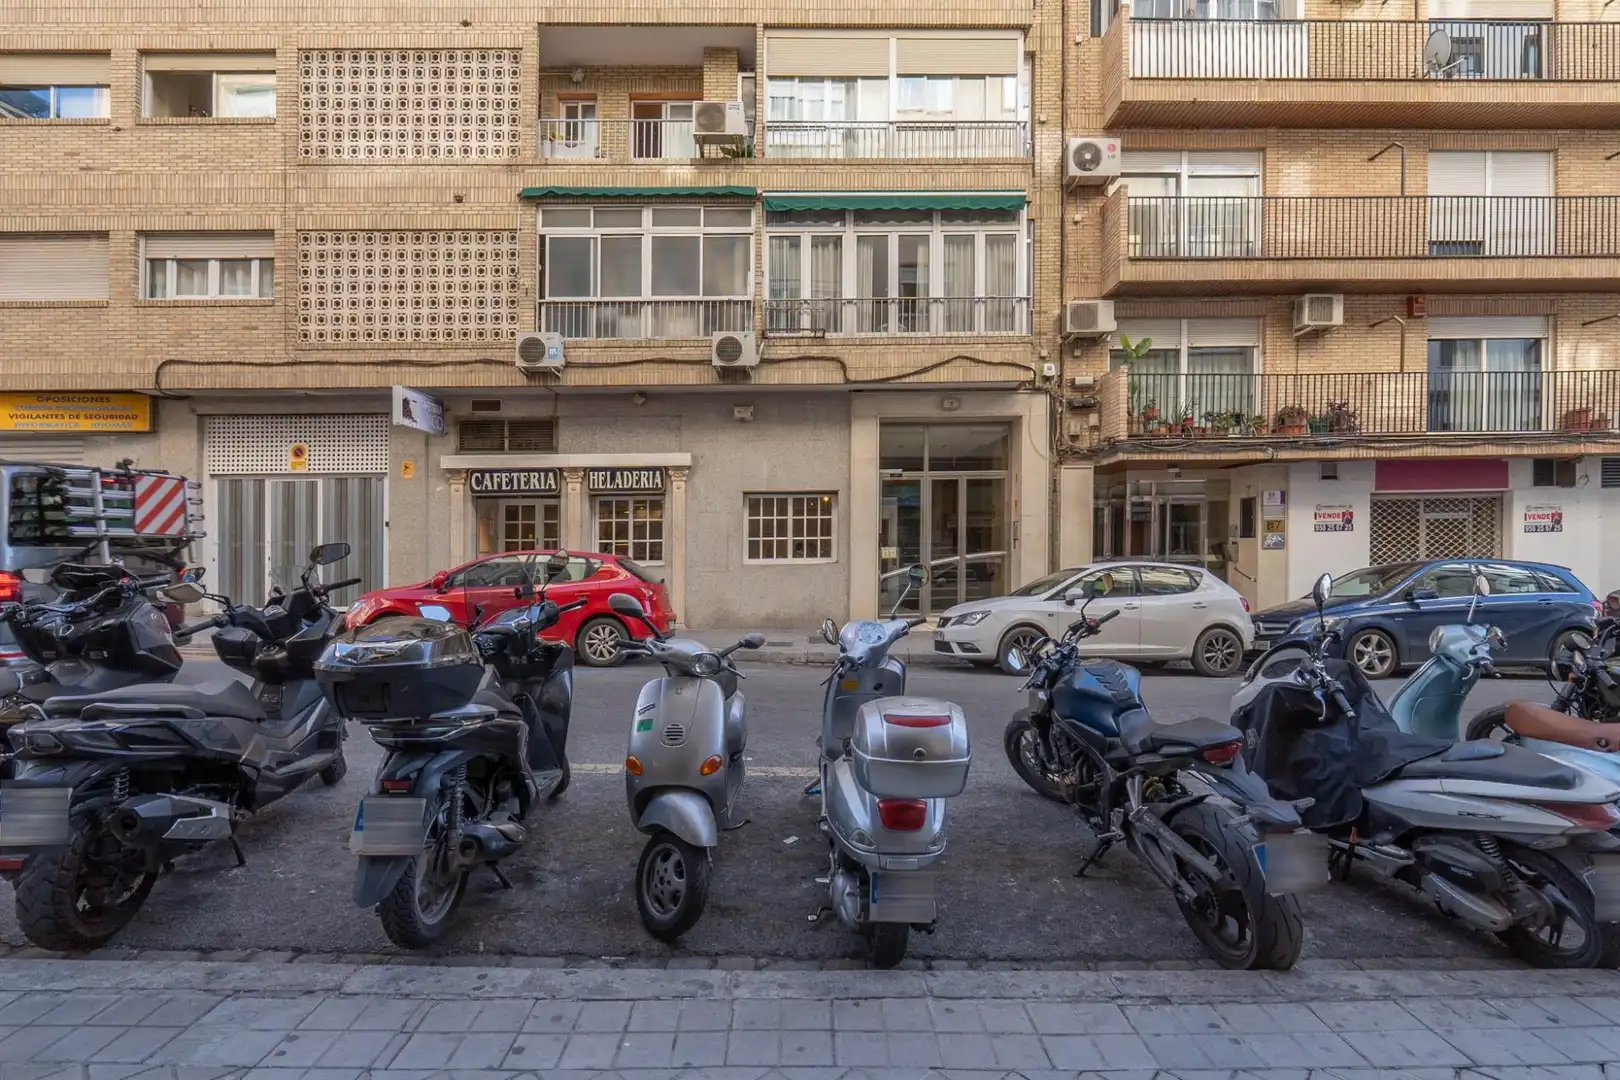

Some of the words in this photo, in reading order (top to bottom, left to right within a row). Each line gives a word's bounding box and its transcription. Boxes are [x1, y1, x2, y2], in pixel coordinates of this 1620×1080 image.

[36, 395, 111, 403] OPOSICIONES
[471, 472, 557, 491] CAFETERIA
[589, 471, 662, 489] HELADERIA
